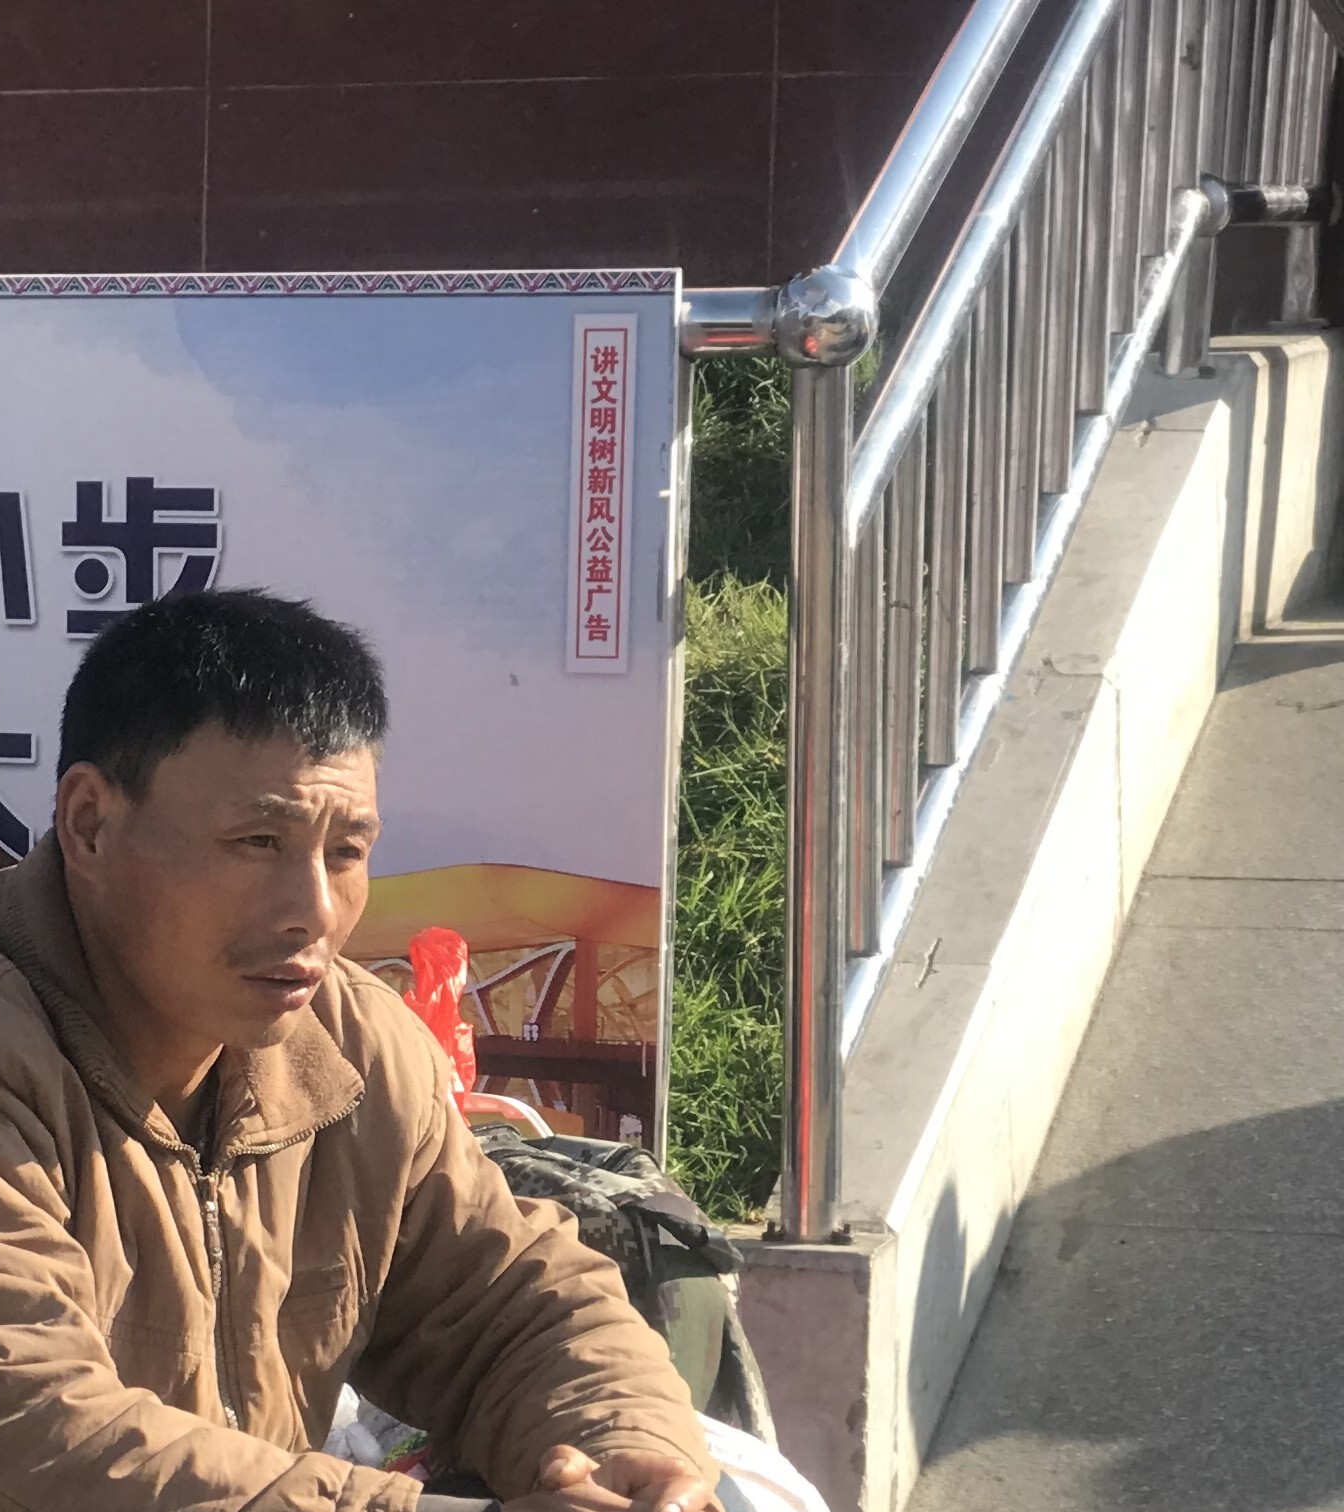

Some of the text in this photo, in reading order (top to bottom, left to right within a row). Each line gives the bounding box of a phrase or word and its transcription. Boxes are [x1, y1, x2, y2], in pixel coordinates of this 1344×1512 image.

[584, 346, 619, 642] 讲文明树新风公益广告
